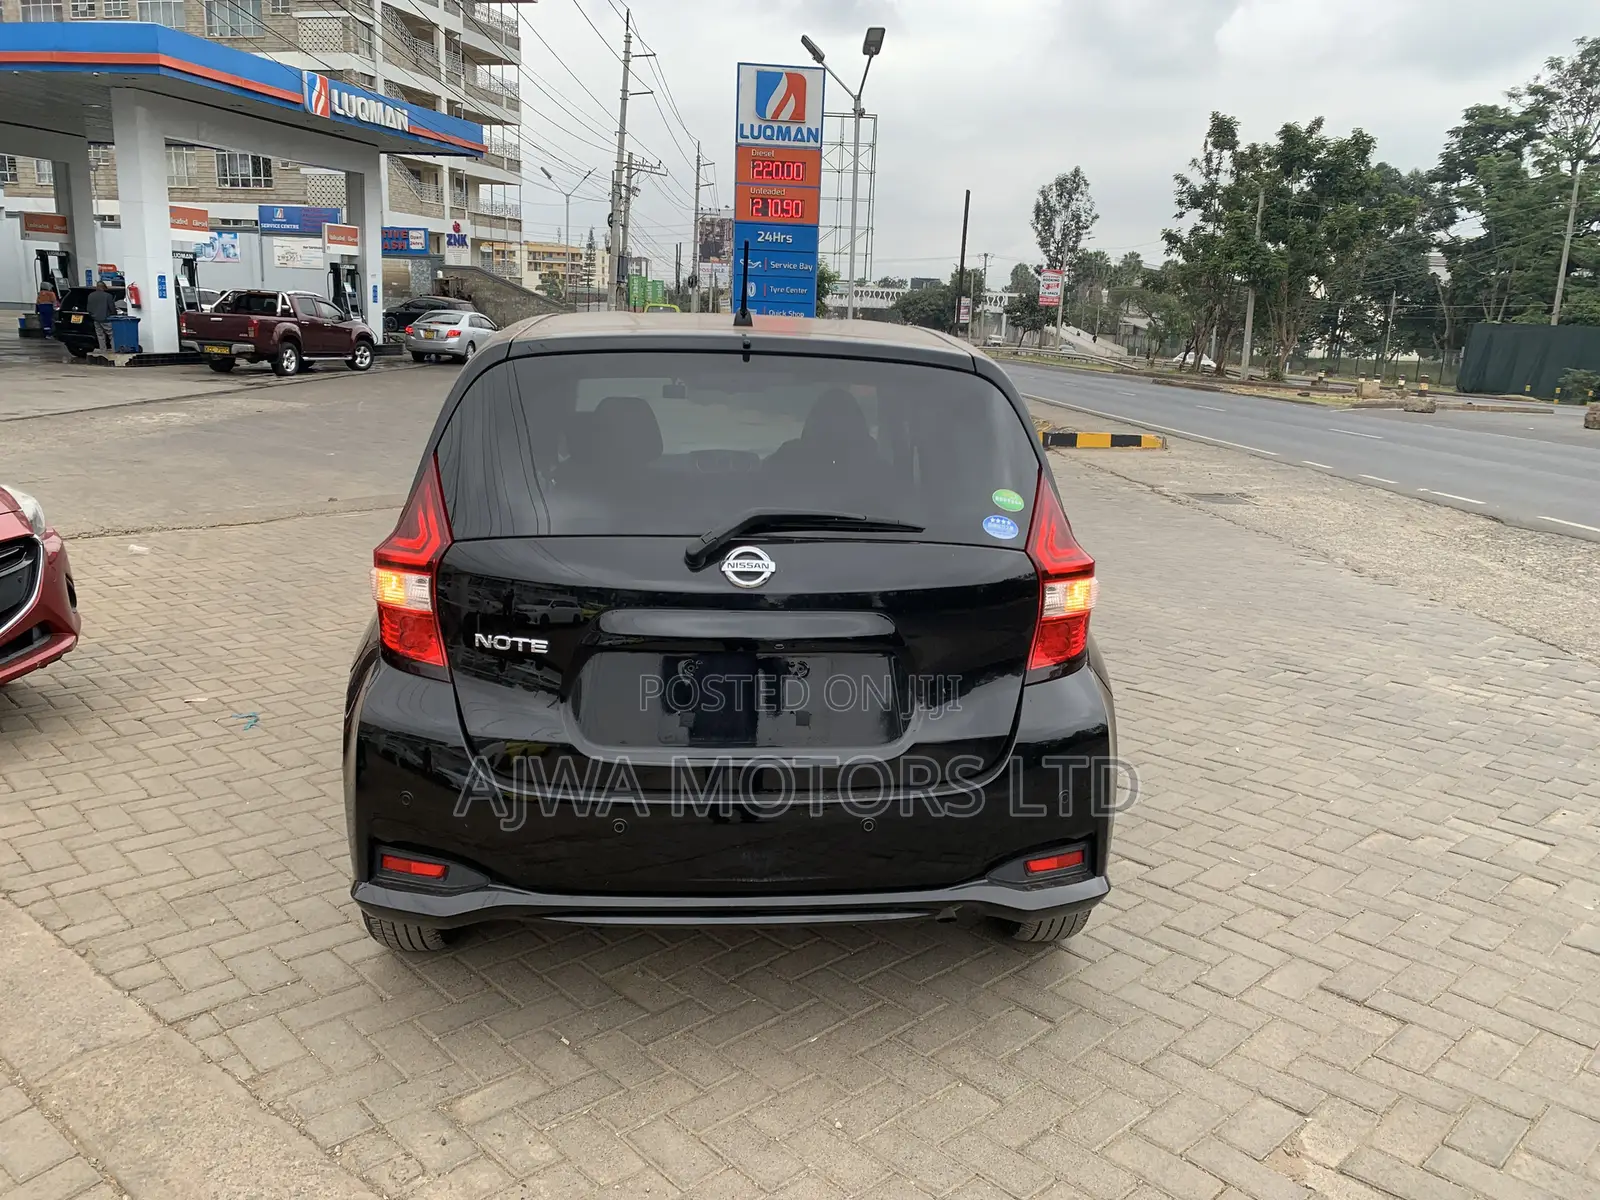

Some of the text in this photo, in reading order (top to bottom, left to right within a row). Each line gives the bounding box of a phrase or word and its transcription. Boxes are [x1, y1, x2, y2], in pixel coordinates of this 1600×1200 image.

[330, 88, 409, 132] LUQMAN
[739, 123, 819, 143] LUQMAN
[751, 149, 775, 158] Diesel
[753, 161, 803, 180] 220.00
[750, 187, 786, 196] Unleaded
[446, 233, 469, 247] ZNK
[757, 231, 793, 244] 24Hrs
[770, 261, 813, 273] Service Bay
[769, 286, 808, 295] Tyre Center
[727, 562, 770, 570] NISSAN
[474, 633, 549, 654] NOTE
